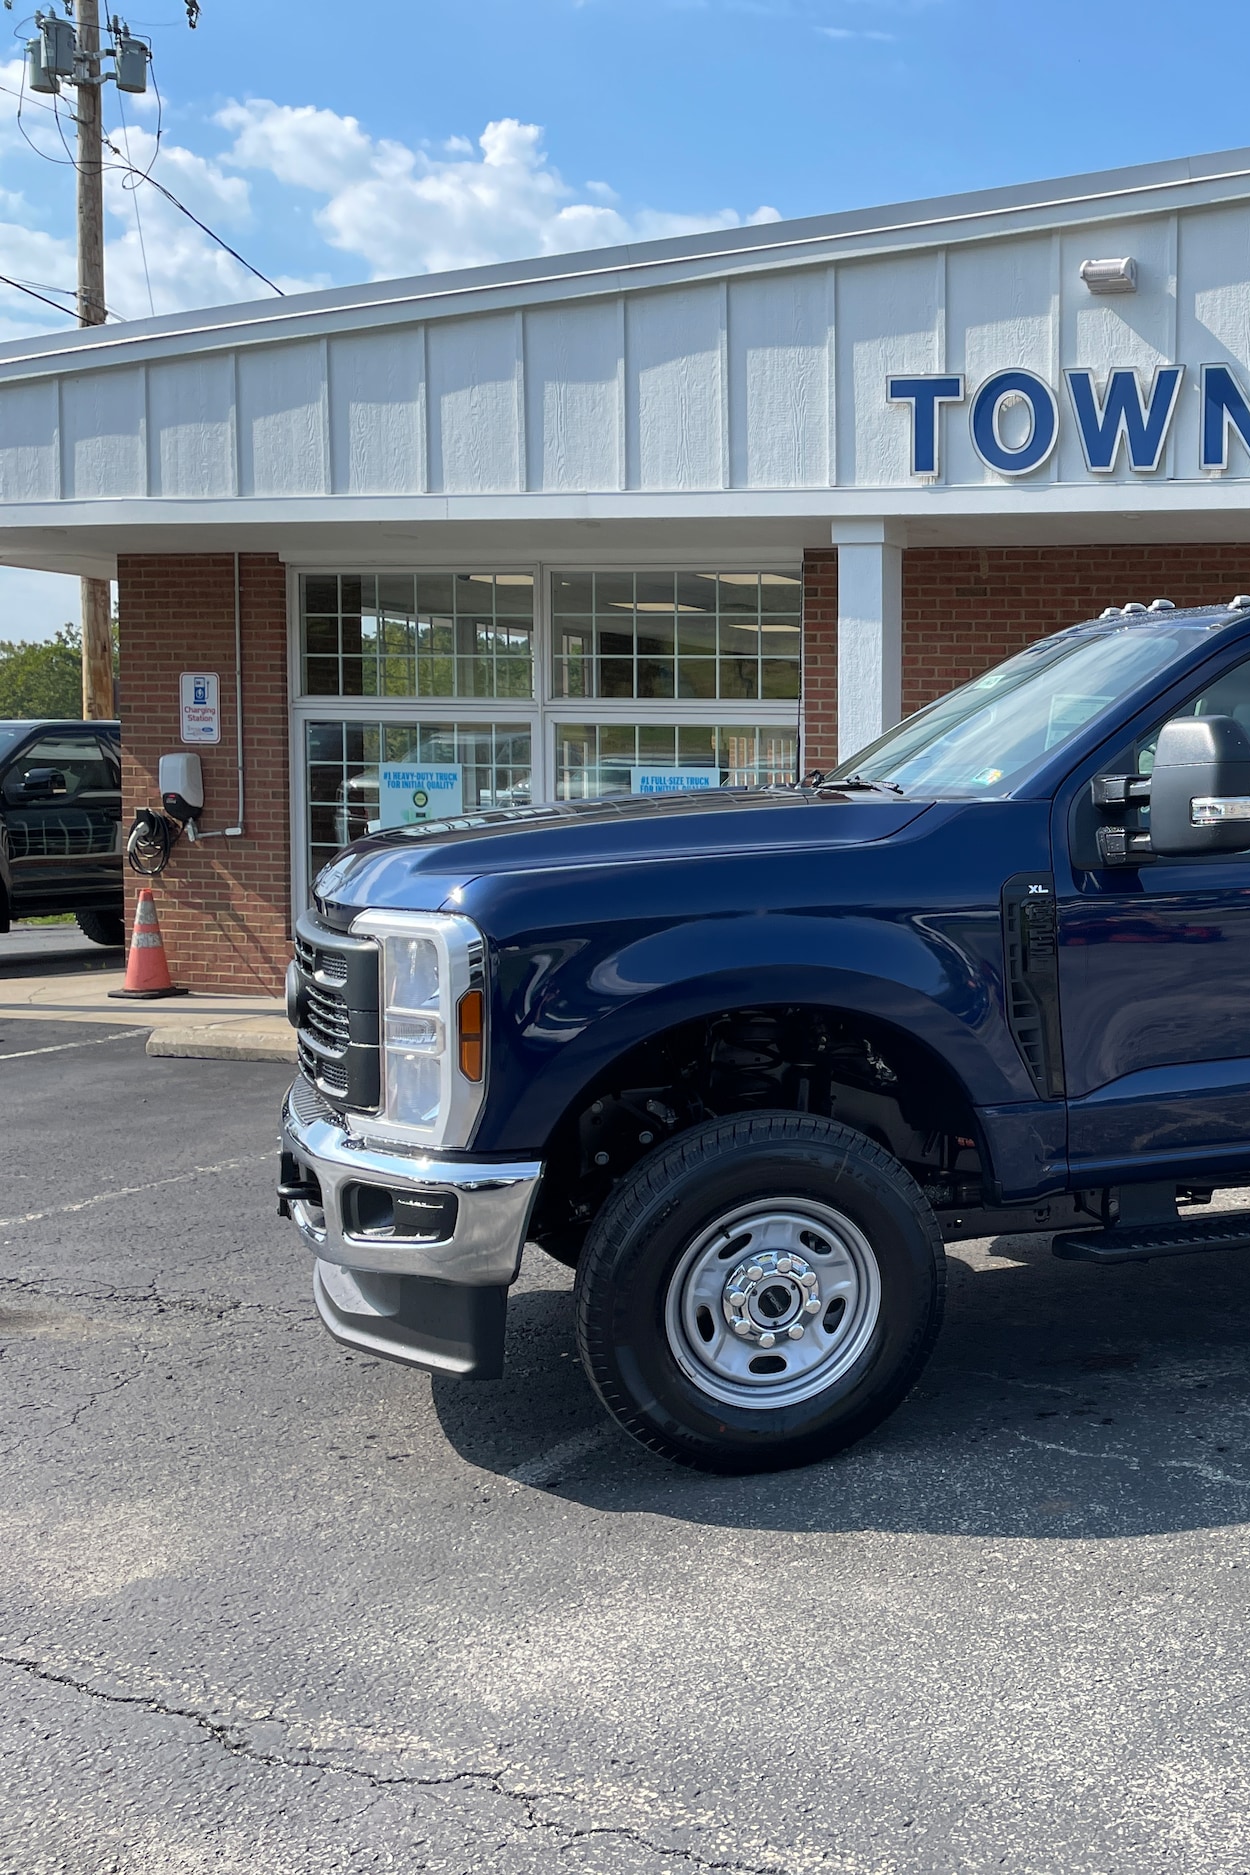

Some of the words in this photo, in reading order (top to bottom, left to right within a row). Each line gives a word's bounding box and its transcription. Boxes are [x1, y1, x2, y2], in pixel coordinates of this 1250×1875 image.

[184, 706, 216, 715] Charging
[187, 714, 213, 722] Station
[383, 772, 391, 780] #1
[393, 772, 434, 780] HEAVY-DUTY
[435, 773, 457, 781] TRUCK
[641, 776, 649, 784] #1
[651, 776, 684, 785] FULL-SIZE
[685, 777, 709, 785] TRUCK
[387, 780, 400, 789] FOR
[401, 781, 425, 789] INITIAL
[426, 781, 454, 791] QUALITY
[640, 785, 654, 793] FOR
[1028, 884, 1049, 894] XL
